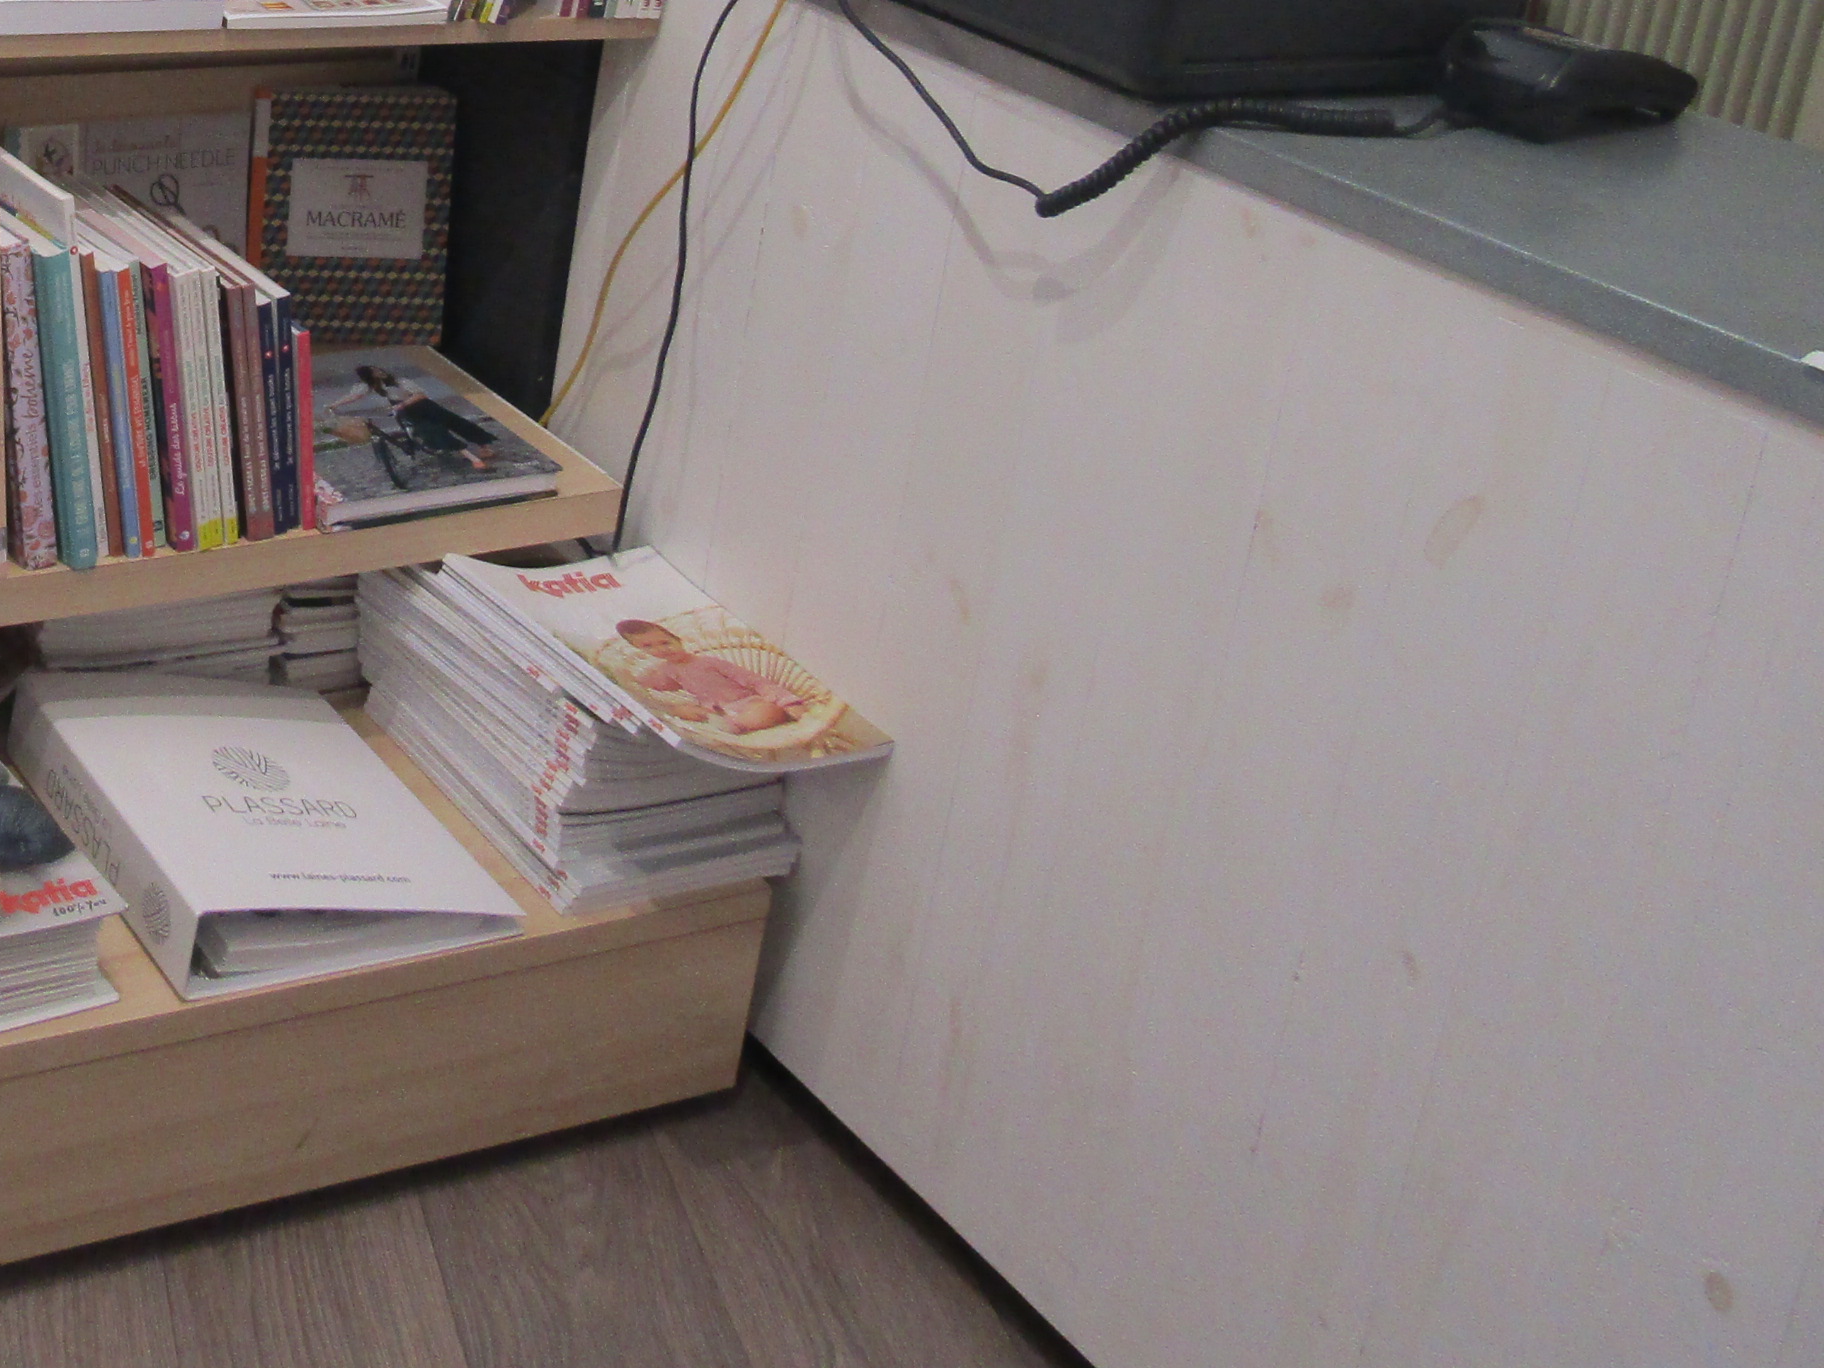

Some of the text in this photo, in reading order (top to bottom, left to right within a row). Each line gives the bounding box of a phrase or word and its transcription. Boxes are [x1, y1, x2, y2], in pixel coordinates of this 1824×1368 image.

[91, 147, 236, 175] PUNCH NEEDLE
[306, 209, 406, 228] MACRAMÉ
[142, 377, 152, 431] HOMEWEAR
[173, 452, 184, 479] guide
[517, 570, 622, 598] katia
[202, 794, 357, 819] PLASSARD
